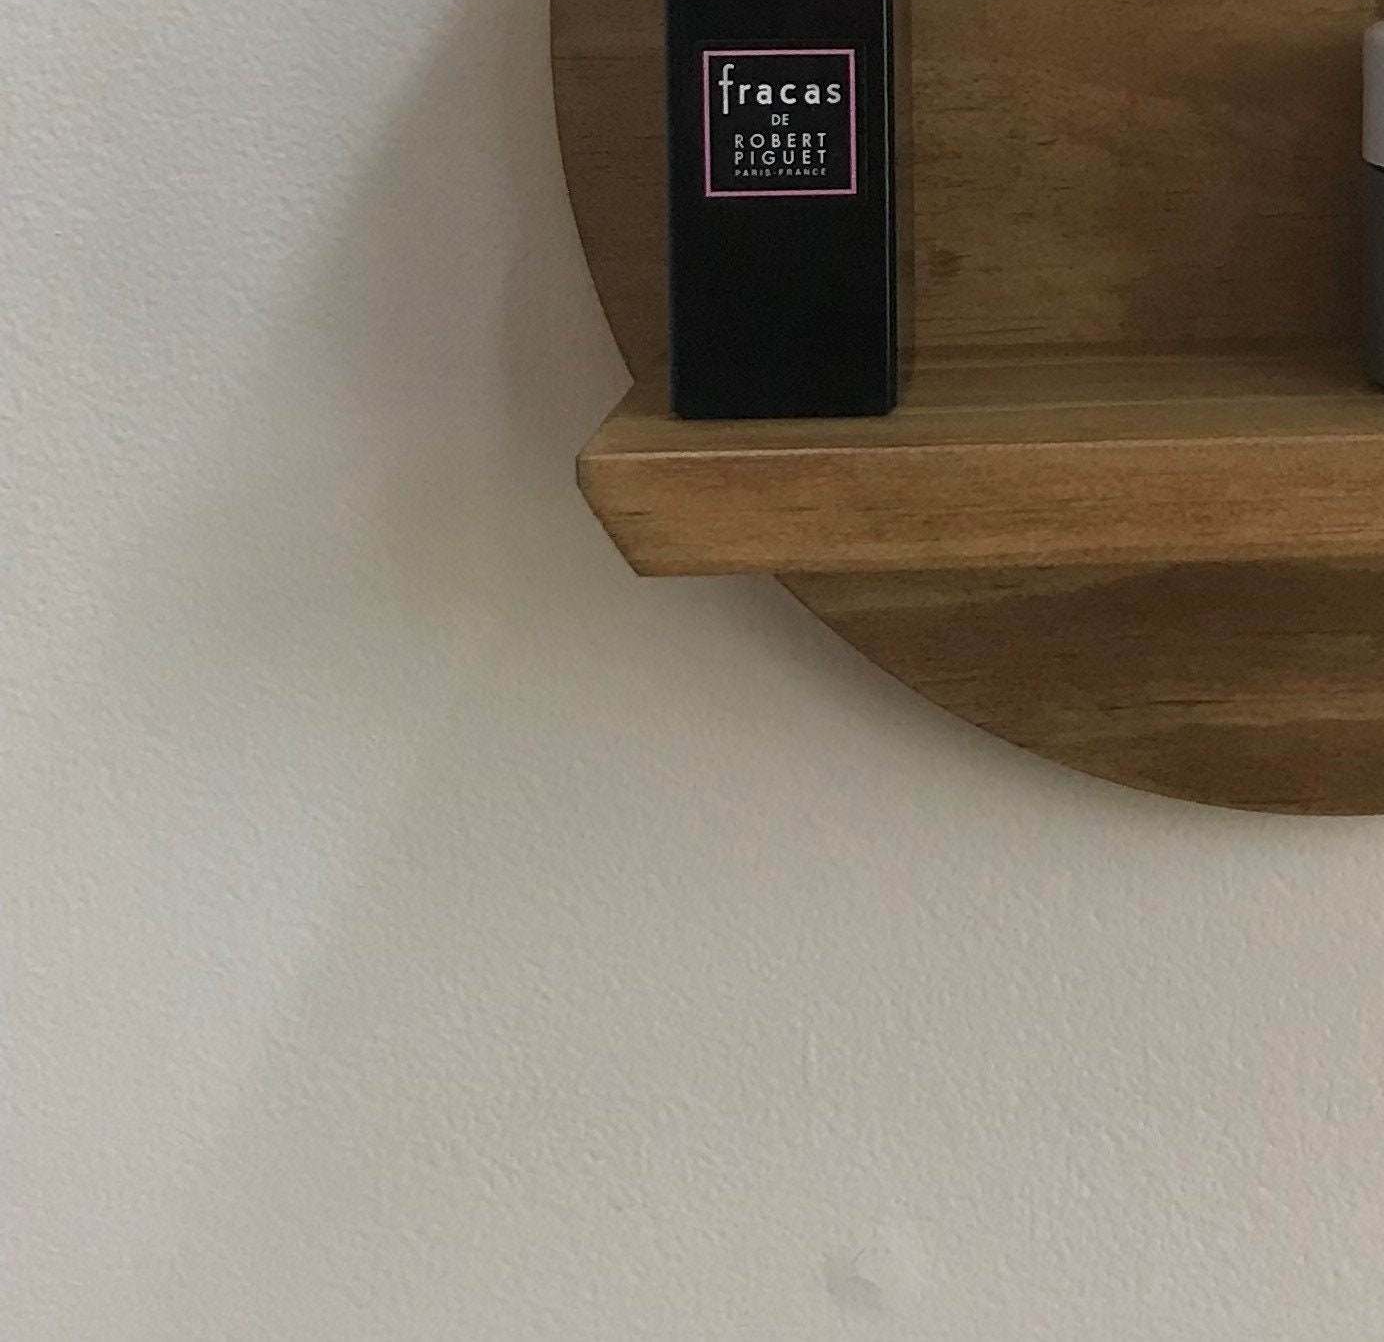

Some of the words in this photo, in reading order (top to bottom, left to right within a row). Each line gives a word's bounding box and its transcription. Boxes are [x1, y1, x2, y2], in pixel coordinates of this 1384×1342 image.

[718, 63, 842, 115] fracas
[771, 113, 790, 126] DE
[734, 132, 827, 149] ROBERT
[734, 149, 827, 165] PIGUET
